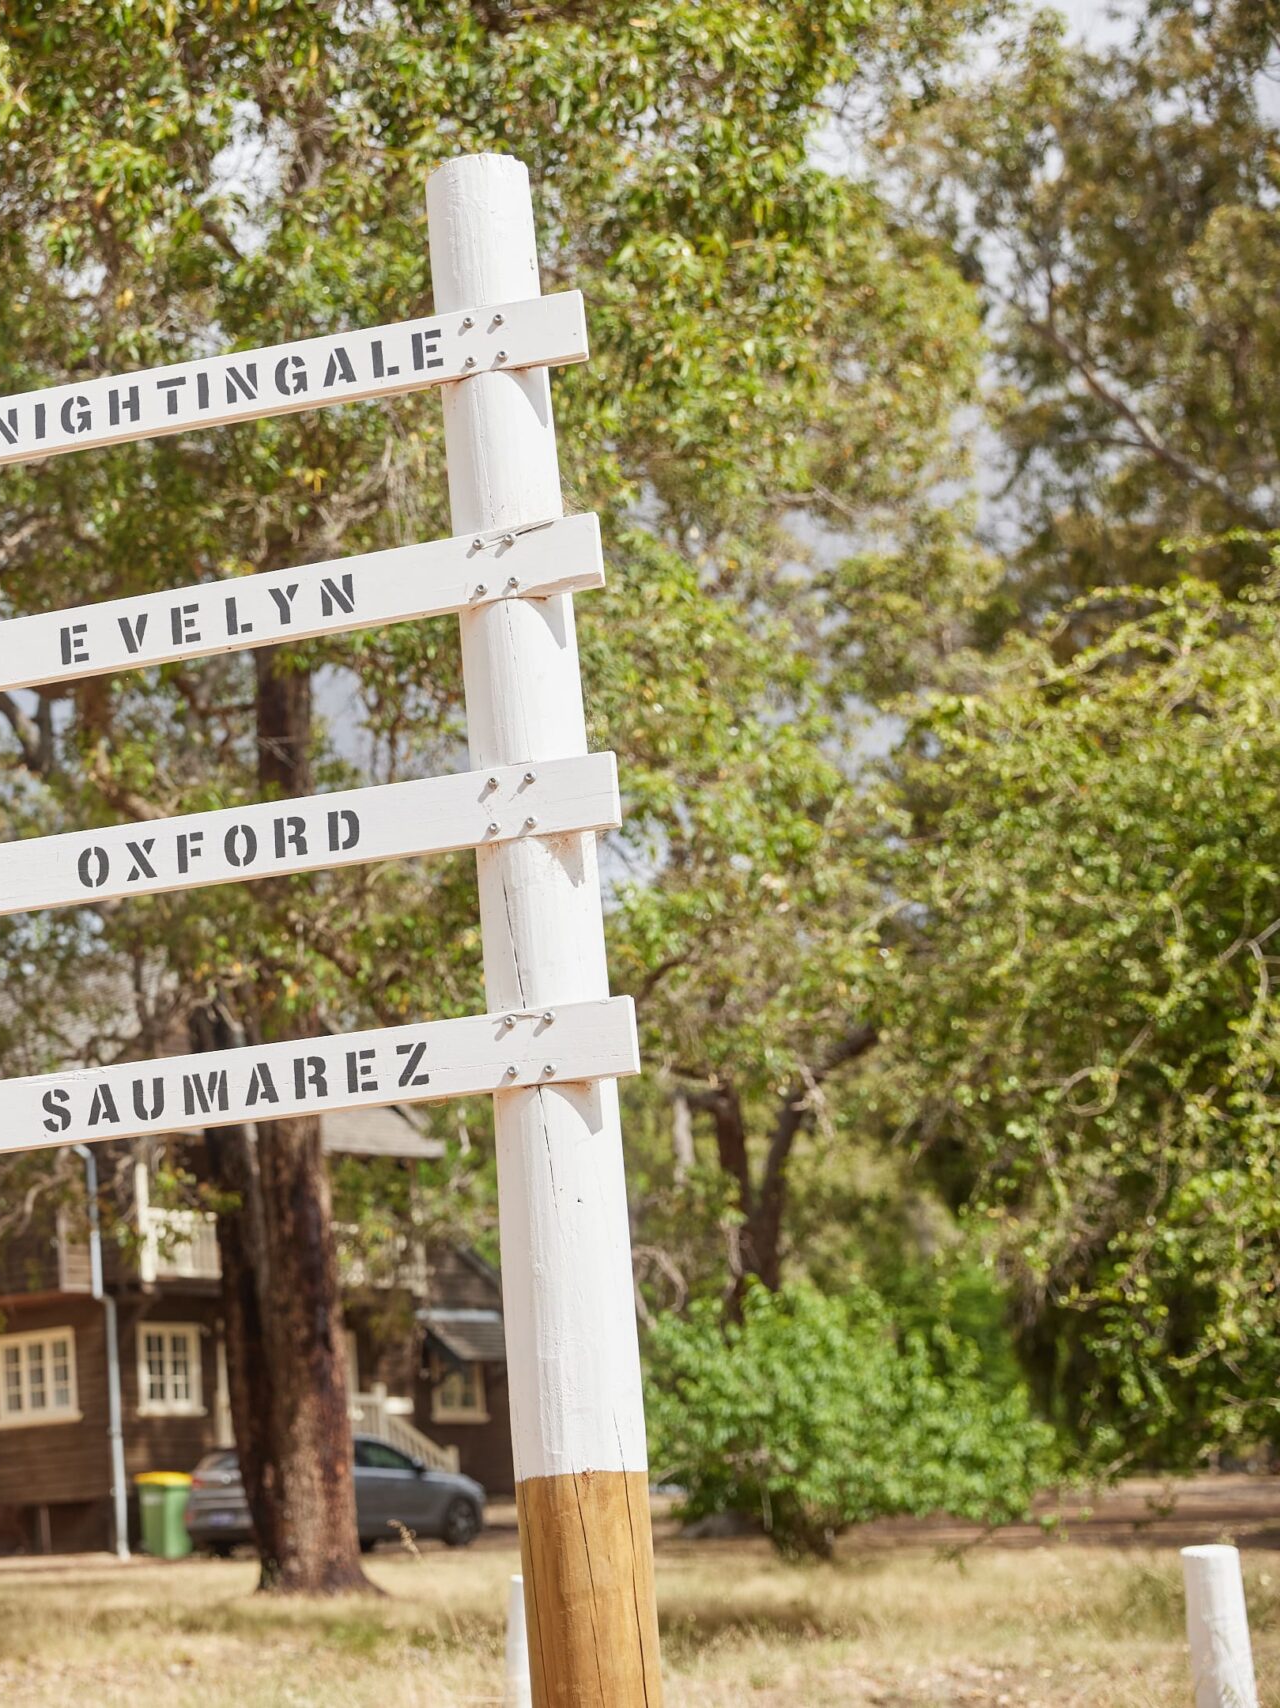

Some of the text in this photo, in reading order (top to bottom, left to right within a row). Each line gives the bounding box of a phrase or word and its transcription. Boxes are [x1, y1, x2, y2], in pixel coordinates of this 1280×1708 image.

[60, 573, 355, 665] EVELYN
[77, 808, 360, 888] OXFORD
[42, 1041, 430, 1132] SAUMAREZ
